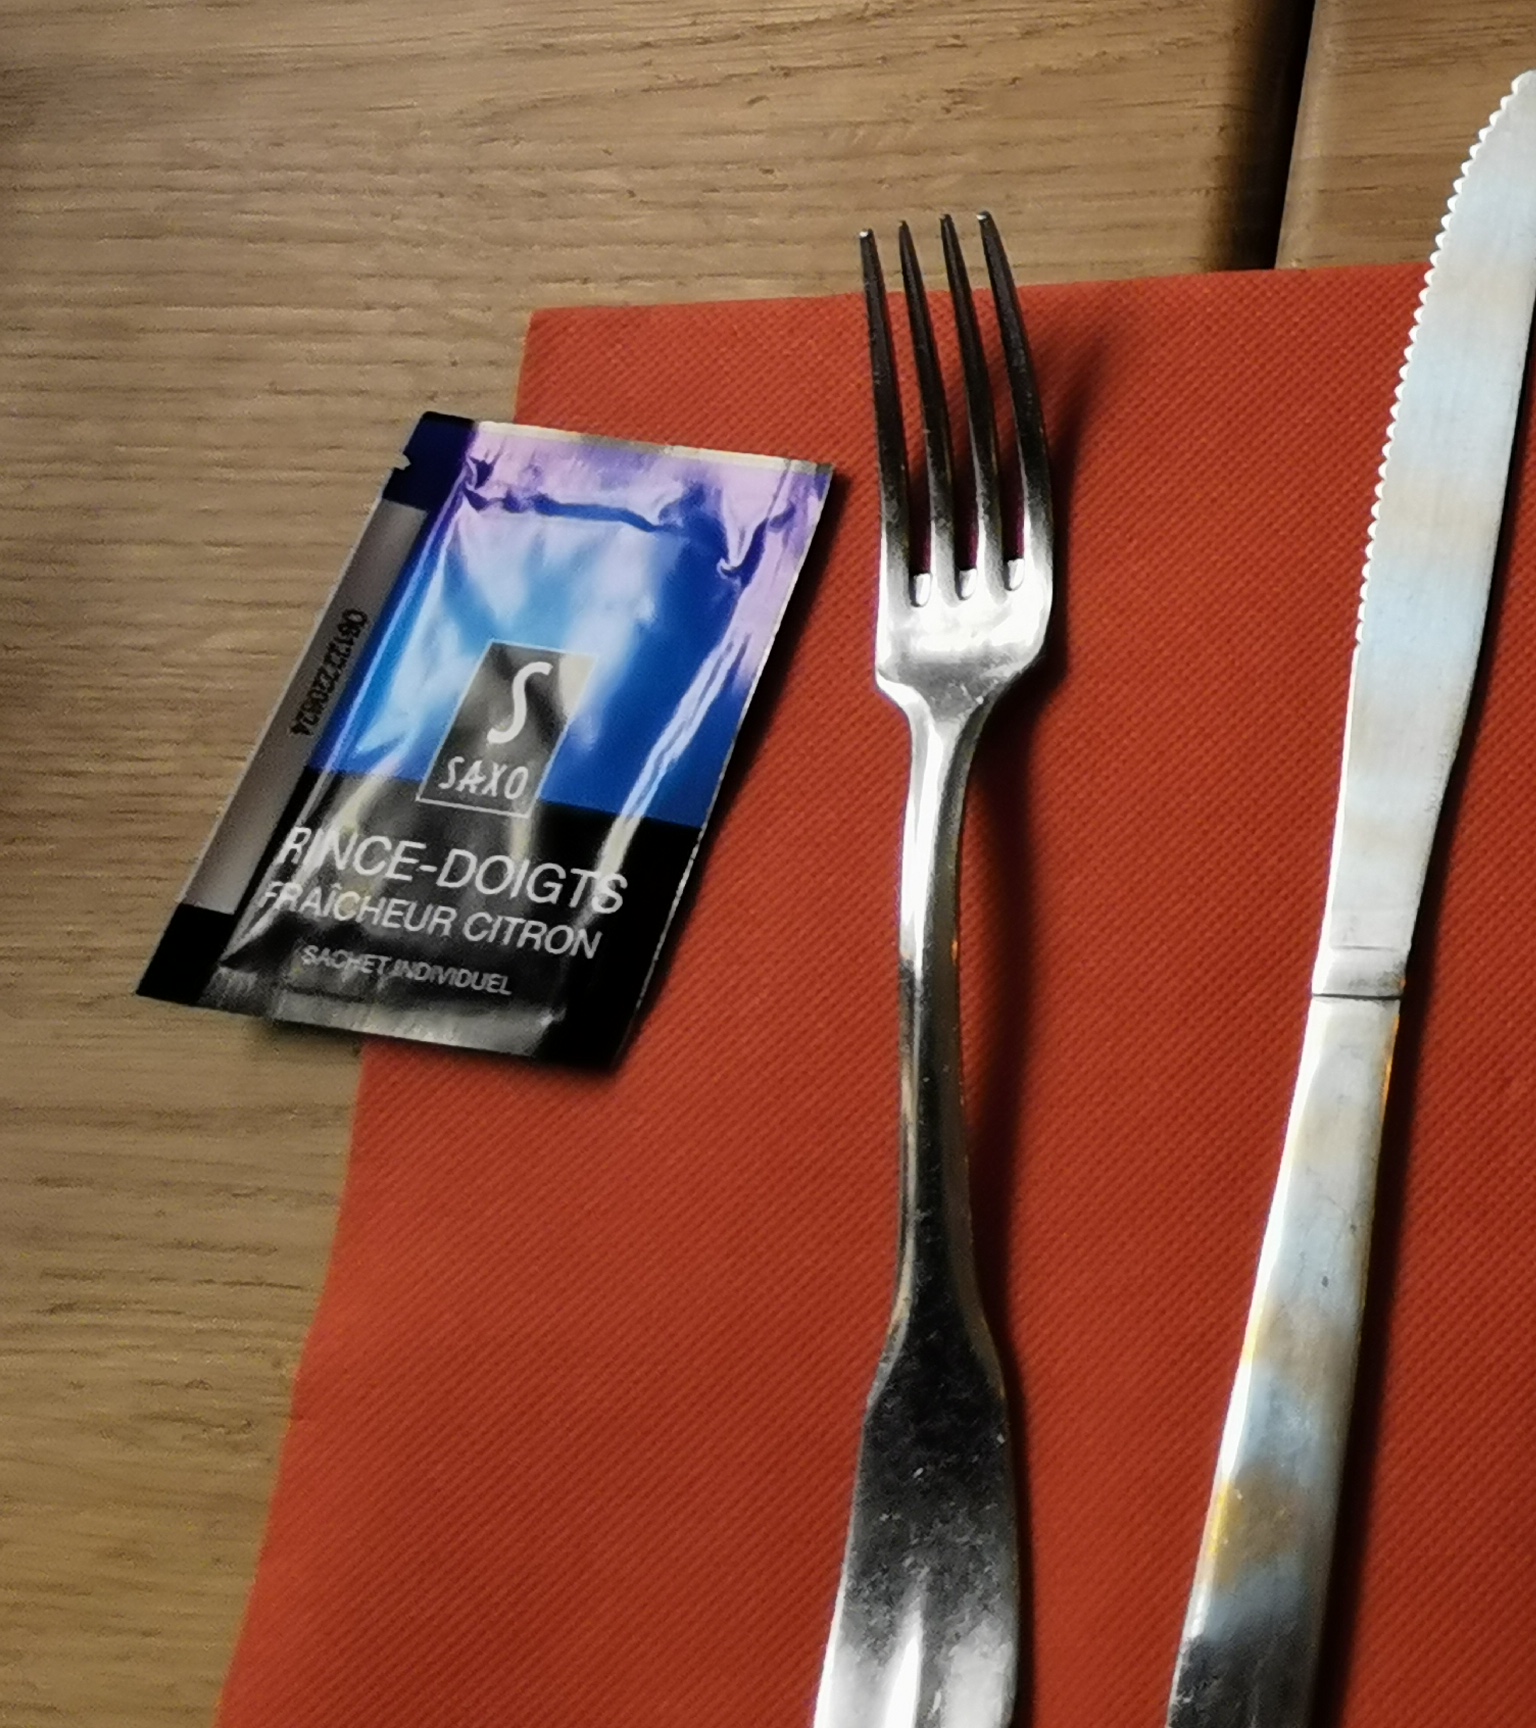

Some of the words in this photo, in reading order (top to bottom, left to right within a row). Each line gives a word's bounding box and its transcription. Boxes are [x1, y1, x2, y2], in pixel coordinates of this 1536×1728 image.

[438, 755, 529, 800] SAXO
[275, 826, 629, 914] RINCE-DOIGTS
[259, 881, 457, 938] FRAÎCHEUR
[463, 911, 602, 960] CITRON
[301, 945, 392, 974] SACHET
[390, 956, 513, 995] INDIVIDUEL
